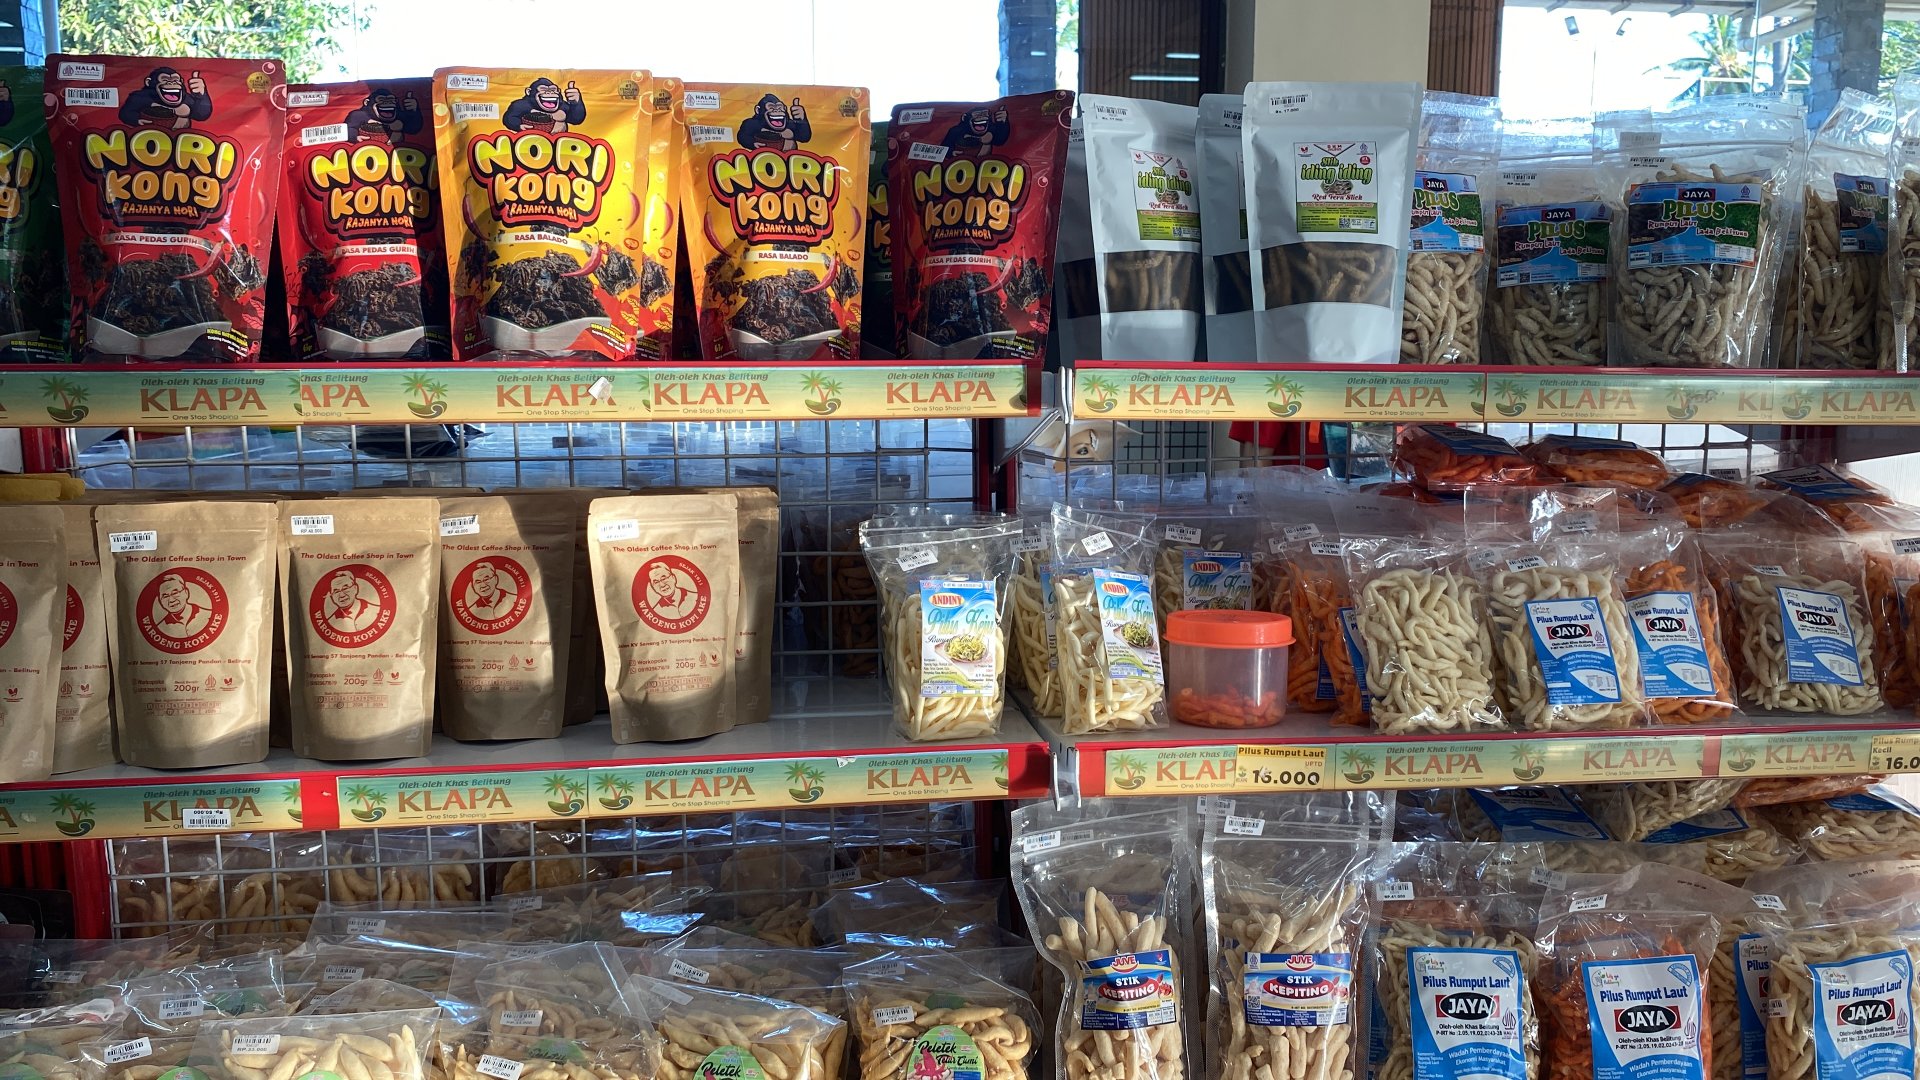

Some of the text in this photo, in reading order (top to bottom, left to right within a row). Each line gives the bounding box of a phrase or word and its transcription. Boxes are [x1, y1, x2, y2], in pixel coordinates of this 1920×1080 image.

[86, 129, 235, 179] NORI
[476, 135, 608, 182] NORI
[311, 145, 437, 190] NORI
[1300, 164, 1373, 185] iding iding
[716, 152, 834, 198] NORI
[914, 160, 1024, 202] NORI
[1138, 171, 1192, 196] iding iding
[1426, 180, 1445, 189] JAYA
[1414, 190, 1459, 211] PILUS
[1683, 190, 1710, 200] JAYA
[122, 202, 198, 217] RAJANYA NORI
[510, 203, 576, 220] RAJANYA NORI
[1546, 210, 1571, 220] JAYA
[1662, 200, 1726, 220] PILUS
[346, 216, 414, 230] RAJANYA NORI
[754, 220, 815, 236] RAJANYA NORI
[1527, 220, 1586, 242] PILUS
[113, 234, 199, 244] RASA PEDAS GURIH
[537, 234, 568, 244] BALADO
[362, 245, 388, 254] PEDAS
[779, 252, 808, 260] BALADO
[142, 378, 265, 386] Oleh-oleh Khas Belitung
[324, 374, 368, 383] Belitung
[654, 372, 768, 382] Oleh-oleh Khas Belitung
[887, 371, 996, 380] Oleh-oleh Khas Belitung
[654, 382, 770, 406] KLAPA
[886, 380, 996, 404] KLAPA
[1129, 384, 1234, 406] KLAPA
[1345, 386, 1448, 408] KLAPA
[1536, 388, 1636, 410] KLAPA
[140, 387, 268, 412] KLAPA
[1820, 391, 1916, 412] KLAPA
[312, 410, 342, 418] Shoping
[196, 555, 214, 564] Shop
[227, 554, 246, 562] Town
[316, 552, 340, 560] Oldest
[342, 552, 364, 560] Coffee
[366, 552, 384, 560] Shop
[1192, 562, 1222, 573] ANDINY
[1102, 582, 1128, 595] ANDINY
[932, 595, 962, 605] ANDINY
[455, 598, 527, 631] WAROENG KOPI AKE
[638, 594, 708, 630] WAROENG KOPI AKE
[1536, 614, 1595, 624] Pilus Rumput Laut
[1652, 608, 1674, 616] Rumput
[1802, 612, 1830, 624] JAYA
[142, 612, 223, 650] WAROENG KOPI AKE
[314, 609, 391, 644] WAROENG KOPI AKE
[1555, 626, 1584, 636] JAYA
[1654, 620, 1679, 630] JAYA
[482, 663, 504, 672] 200gr
[676, 662, 696, 670] 200gr
[174, 684, 200, 694] 200gr
[344, 678, 368, 686] 200gr
[1238, 746, 1324, 758] Pilus Rumput Laut
[1584, 746, 1676, 770] KLAPA
[1764, 742, 1856, 764] KLAPA
[1384, 754, 1484, 776] KLAPA
[867, 764, 972, 790] KLAPA
[644, 774, 756, 800] KLAPA
[398, 788, 512, 812] KLAPA
[1112, 955, 1136, 967] JUVE
[1287, 954, 1313, 966] JUVE
[1747, 960, 1769, 972] Pilus
[1116, 976, 1140, 986] STIK
[1286, 974, 1314, 984] STIK
[1422, 976, 1510, 990] Pilus Rumput Laut
[1103, 984, 1155, 1000] KEPITING
[1269, 984, 1329, 998] KEPITING
[1600, 986, 1688, 1003] Pilus Rumput Laut
[1448, 998, 1490, 1015] JAYA
[1848, 1004, 1887, 1020] JAYA
[1627, 1010, 1668, 1028] JAYA
[918, 1040, 957, 1054] Peletek
[1448, 1047, 1511, 1059] Wadah Pemberdayaan
[935, 1054, 978, 1066] Telur Cumi
[1456, 1056, 1506, 1066] Ekonomi Masyarakat
[1630, 1059, 1692, 1072] Wadah Pemberdayaan
[702, 1062, 740, 1078] Peletek
